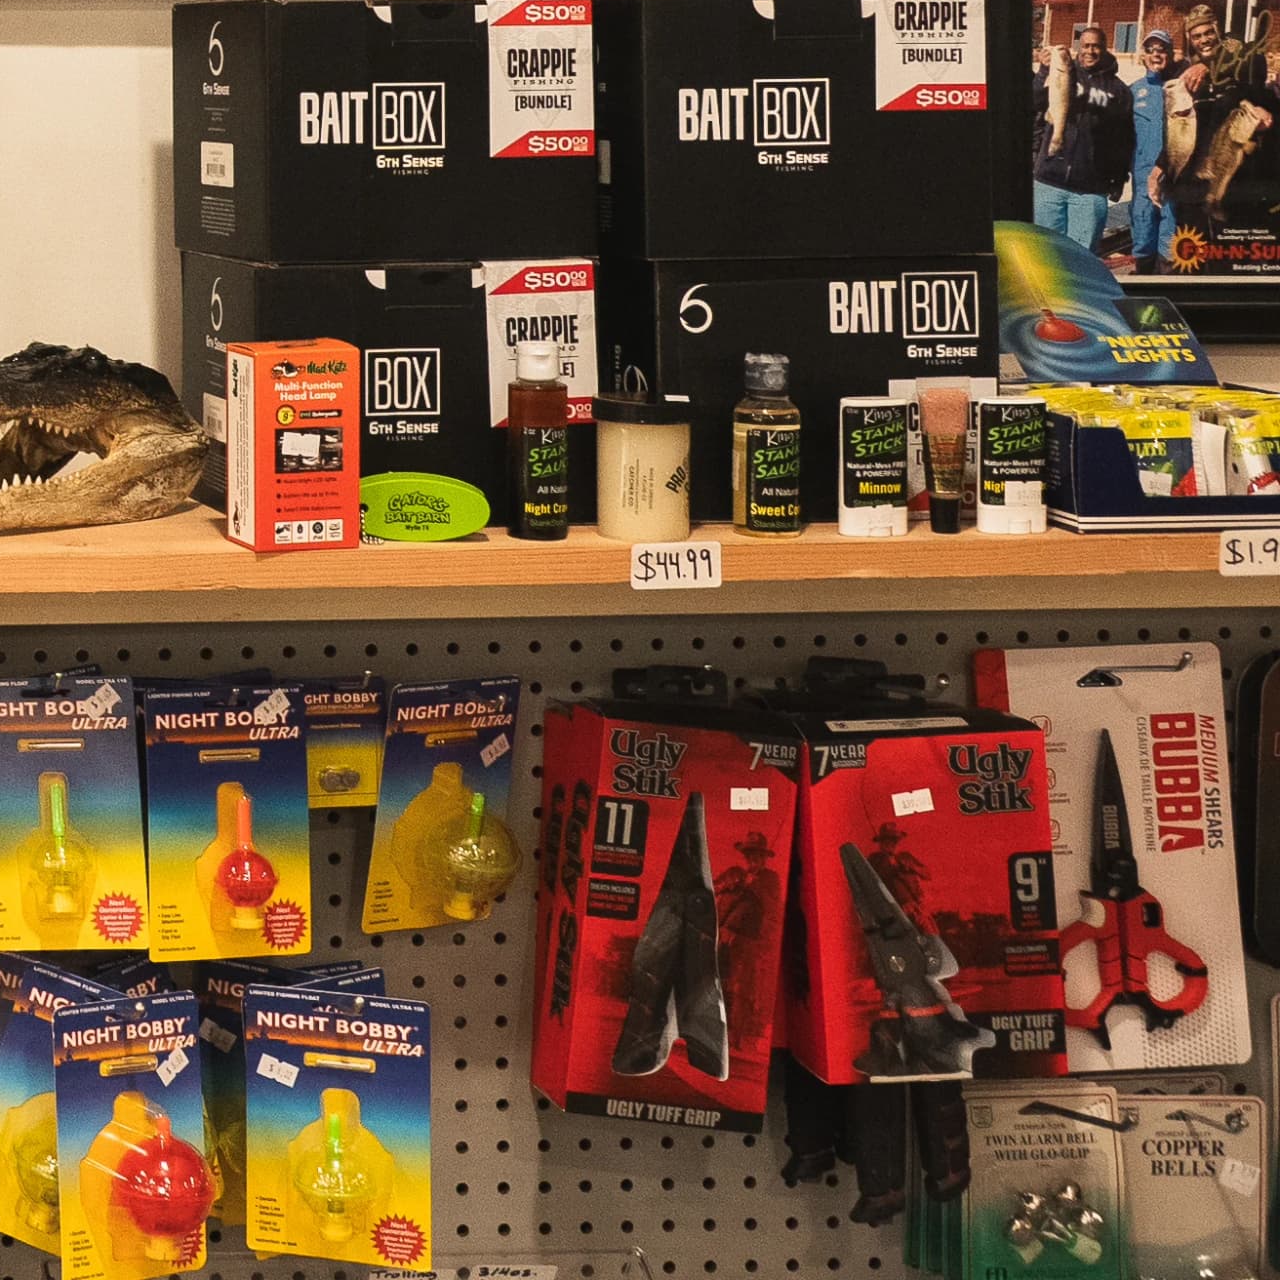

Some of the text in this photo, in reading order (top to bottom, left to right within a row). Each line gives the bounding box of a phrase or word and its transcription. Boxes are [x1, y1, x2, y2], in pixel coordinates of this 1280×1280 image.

[894, 1, 967, 30] CRAPPIE
[507, 48, 577, 79] CRAPPIE
[902, 48, 962, 64] [BUNDLE]
[515, 94, 572, 111] [BUNDLE]
[299, 91, 437, 144] BAIT BOX
[678, 87, 820, 141] BAIT BOX
[829, 280, 970, 334] BAIT BOX
[506, 314, 579, 346] CRAPPIE
[1112, 349, 1196, 363] LIGHTS
[274, 379, 343, 392] Multi-Function
[279, 390, 337, 401] Head Lamp
[850, 421, 904, 443] STANK
[988, 420, 1044, 440] STANK
[859, 482, 901, 494] Minnow
[385, 511, 450, 524] BAIT BARN
[751, 503, 785, 516] Sweet
[635, 549, 712, 582] $44.99
[71, 717, 128, 730] ULTRA
[471, 714, 512, 728] ULTRA
[249, 726, 299, 740] ULTRA
[609, 728, 687, 770] Ugly
[946, 743, 1033, 782] Ugly
[1139, 760, 1149, 772] DE
[611, 764, 681, 799] Stik
[1140, 773, 1152, 801] TAILLE
[1150, 712, 1205, 854] BUBBA
[1198, 714, 1224, 850] MEDIUM SHEARS
[957, 782, 1035, 816] Stik
[605, 802, 633, 845] 11
[1102, 805, 1121, 849] BUBBA
[1143, 803, 1156, 853] MOYENNE
[63, 1018, 185, 1048] NIGHT BOBBY
[257, 1011, 412, 1040] NIGHT BOBBY
[992, 1014, 1055, 1031] UGLY TUFF
[148, 1034, 195, 1052] ULTRA
[363, 1039, 424, 1057] ULTRA
[1009, 1030, 1056, 1052] GRIP
[606, 1099, 721, 1127] UGLY TUFF GRIP
[984, 1132, 1097, 1147] TWIN ALARM BELL
[1142, 1139, 1225, 1157] COPPER
[1150, 1159, 1217, 1177] BELLS
